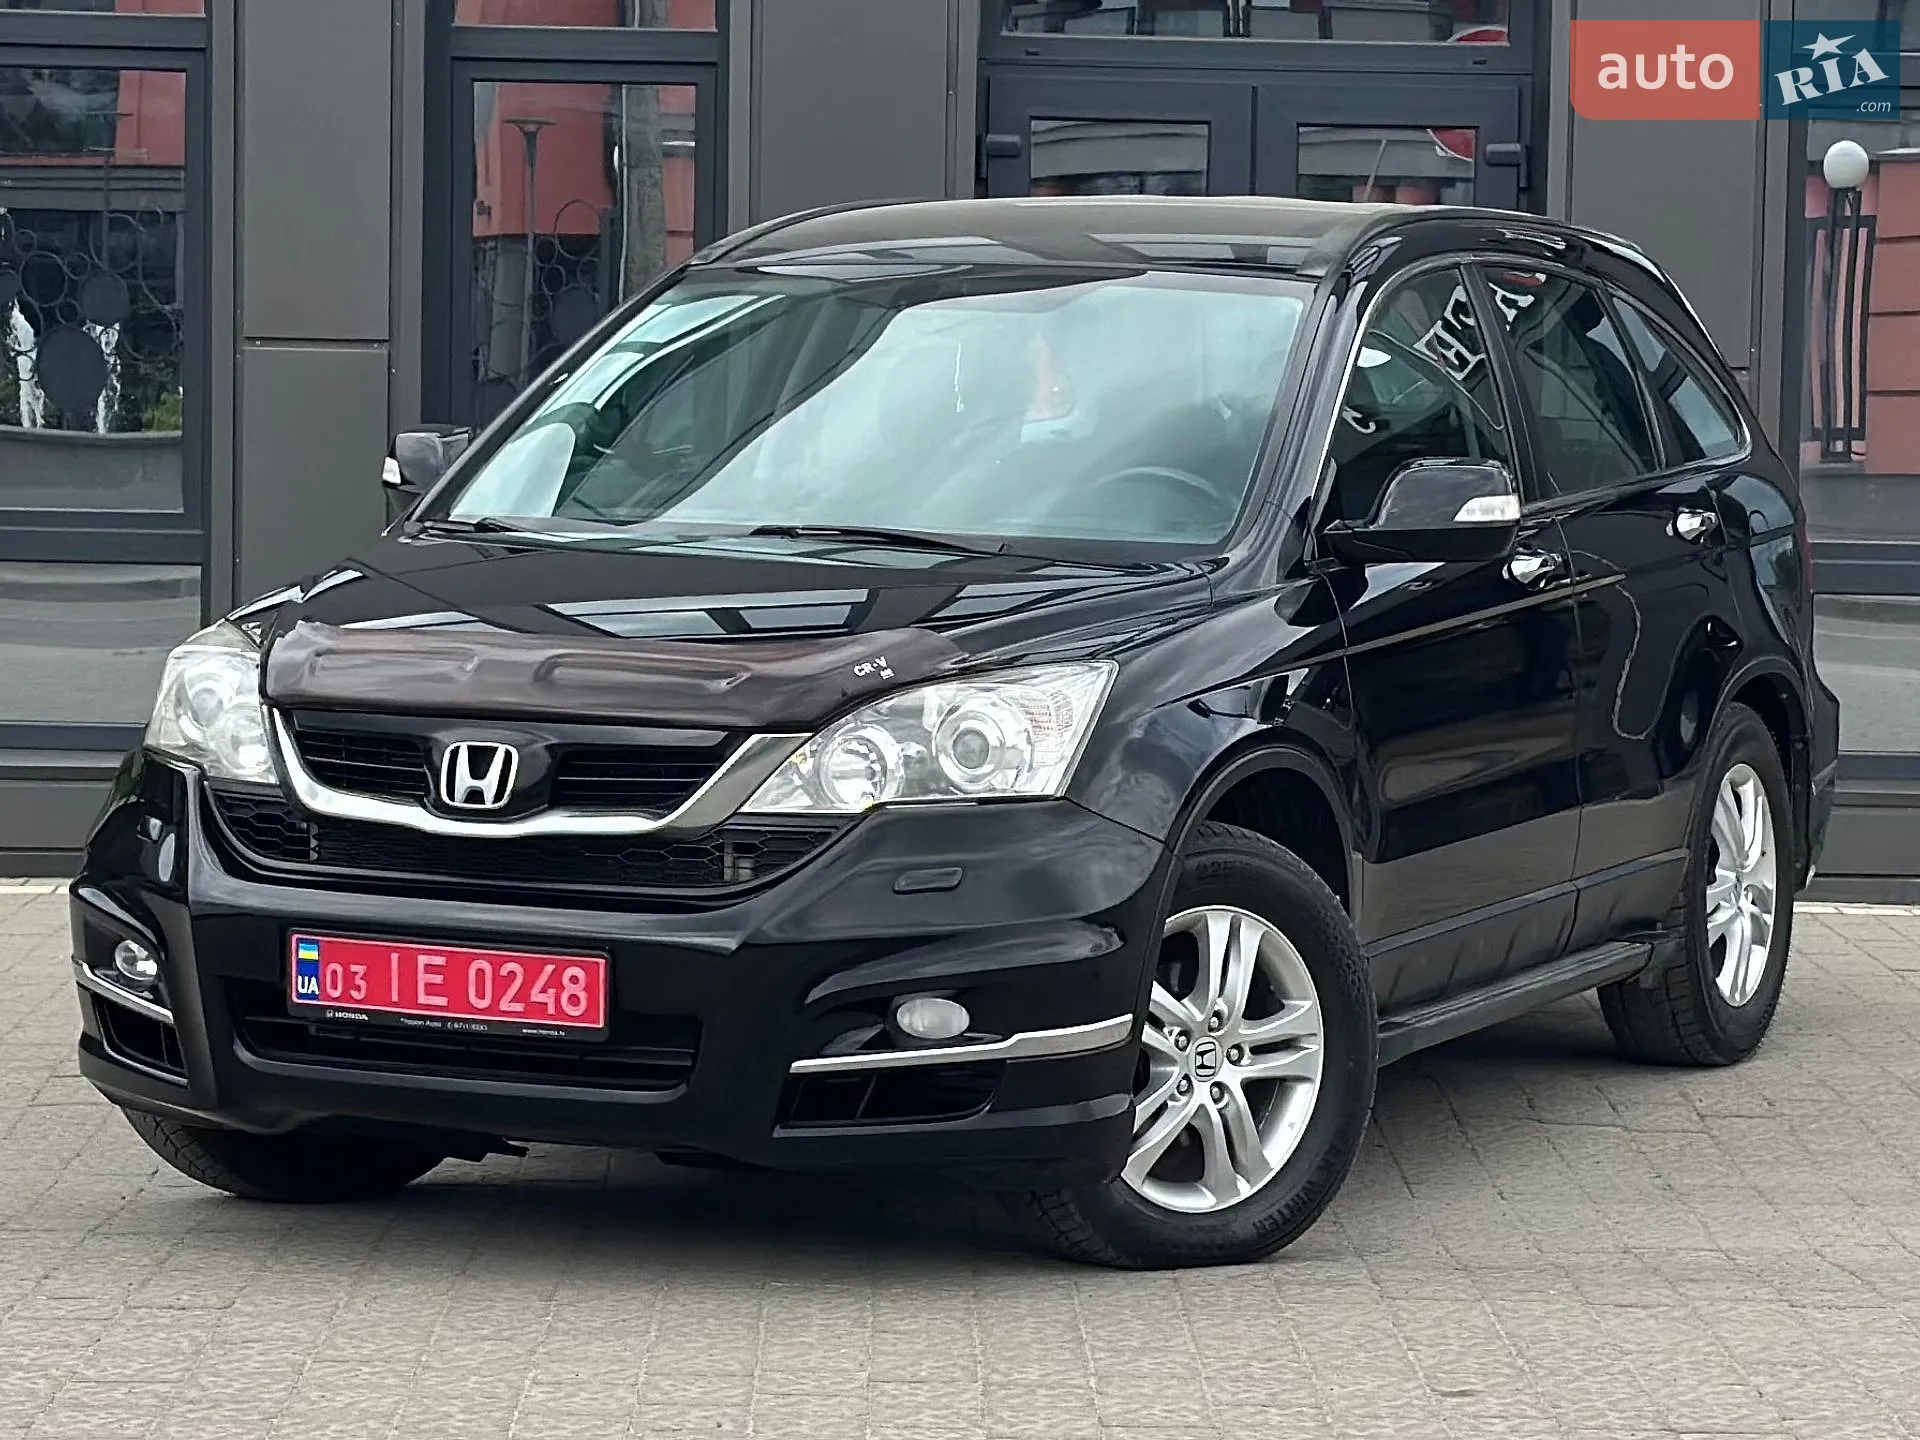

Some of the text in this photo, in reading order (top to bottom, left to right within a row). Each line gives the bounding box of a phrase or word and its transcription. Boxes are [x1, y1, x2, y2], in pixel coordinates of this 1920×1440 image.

[854, 656, 887, 676] CR-V
[298, 975, 319, 995] UA
[325, 952, 588, 1017] 03 IE 0248
[335, 1011, 369, 1020] HONDA
